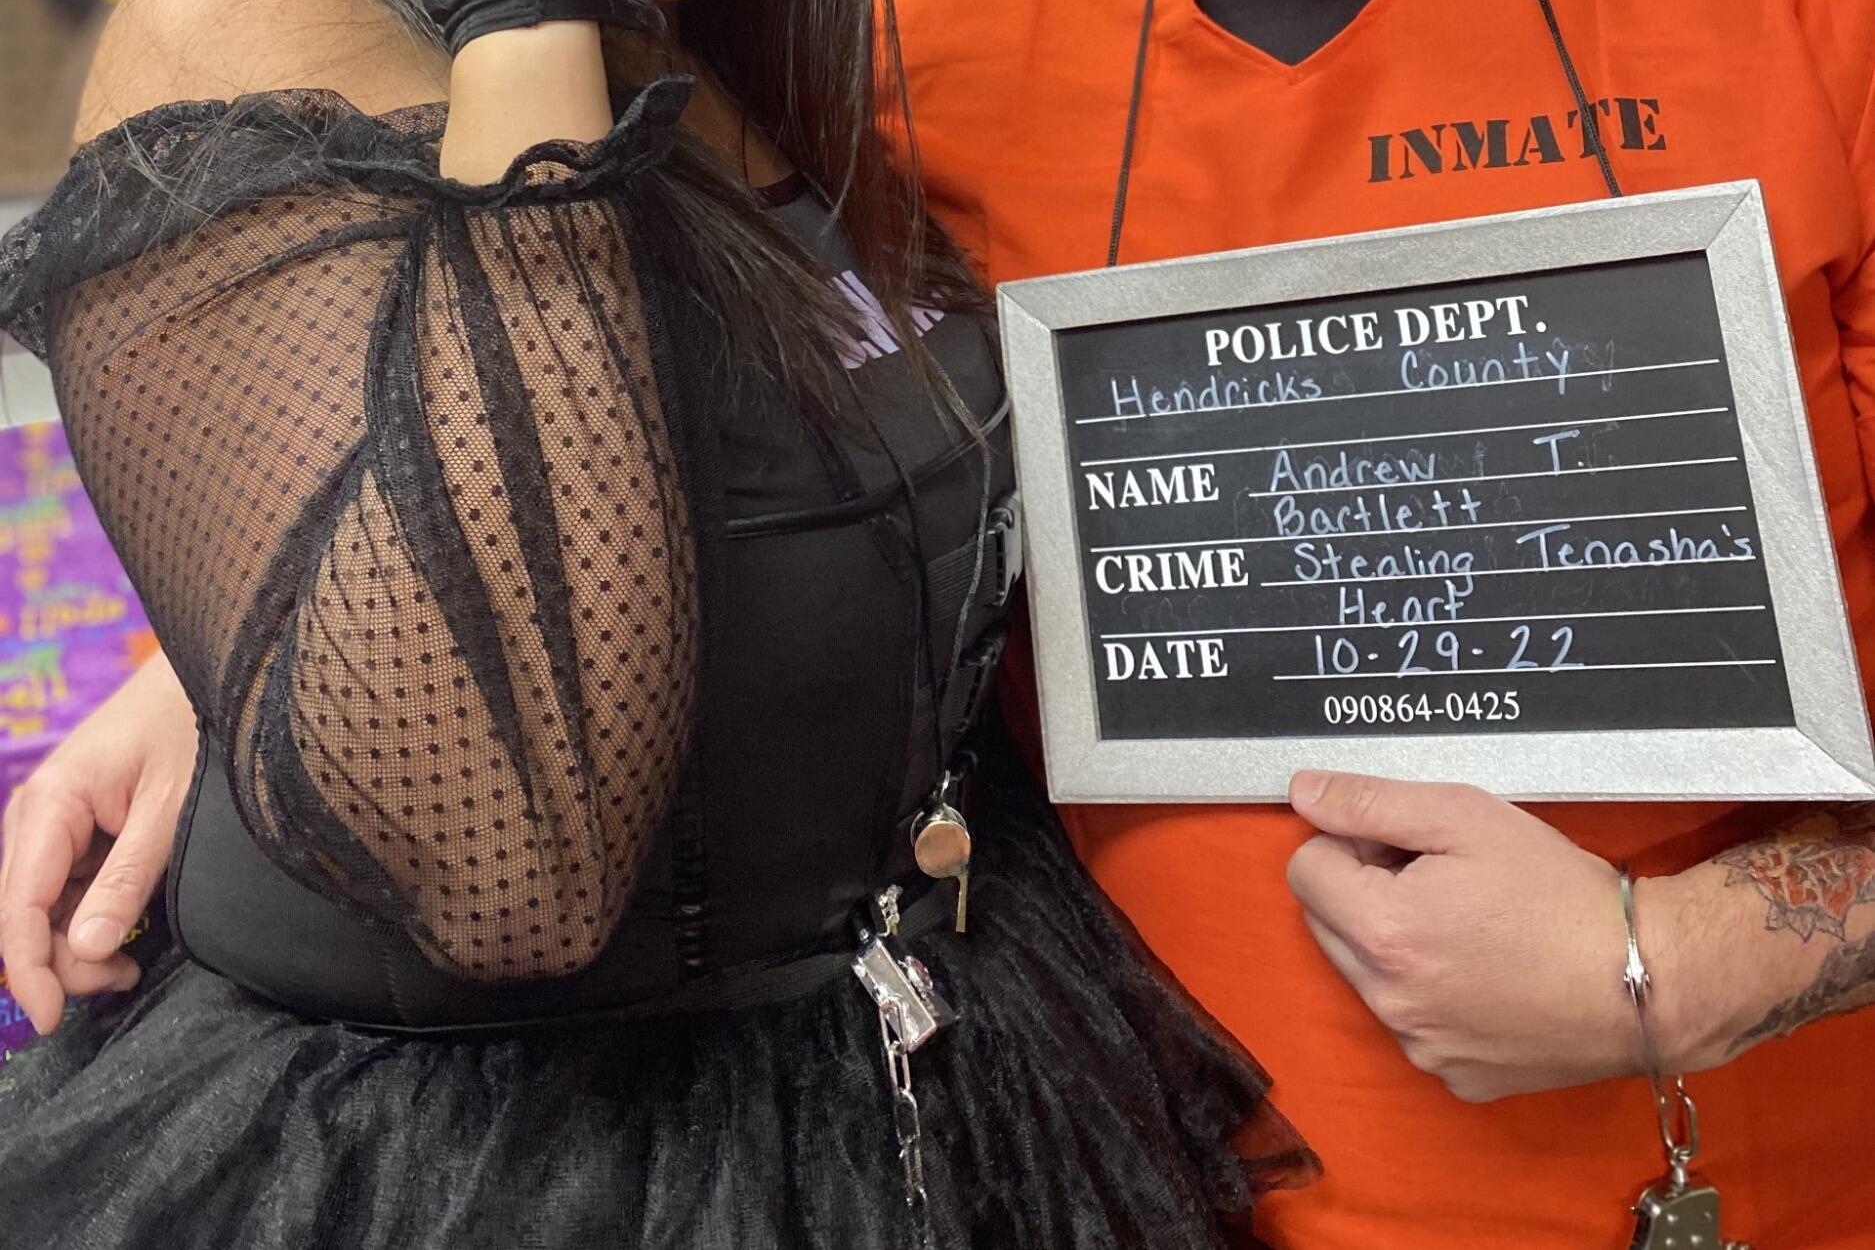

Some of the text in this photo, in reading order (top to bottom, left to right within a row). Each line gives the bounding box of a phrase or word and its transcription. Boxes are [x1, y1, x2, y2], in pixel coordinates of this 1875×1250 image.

[1367, 97, 1667, 183] INMATE
[1205, 295, 1548, 367] POLICE DEPT.
[1111, 341, 1569, 417] Hendricks County
[1270, 429, 1584, 493] Andrew T.
[1085, 463, 1220, 510] NAME
[1274, 488, 1482, 536] Bartlett
[1095, 547, 1250, 594] CRIME
[1294, 523, 1753, 598] Stealing Tenasha's
[1338, 580, 1464, 628] Heart
[1104, 638, 1230, 681] DATE
[1324, 691, 1521, 724] 090864-0425
